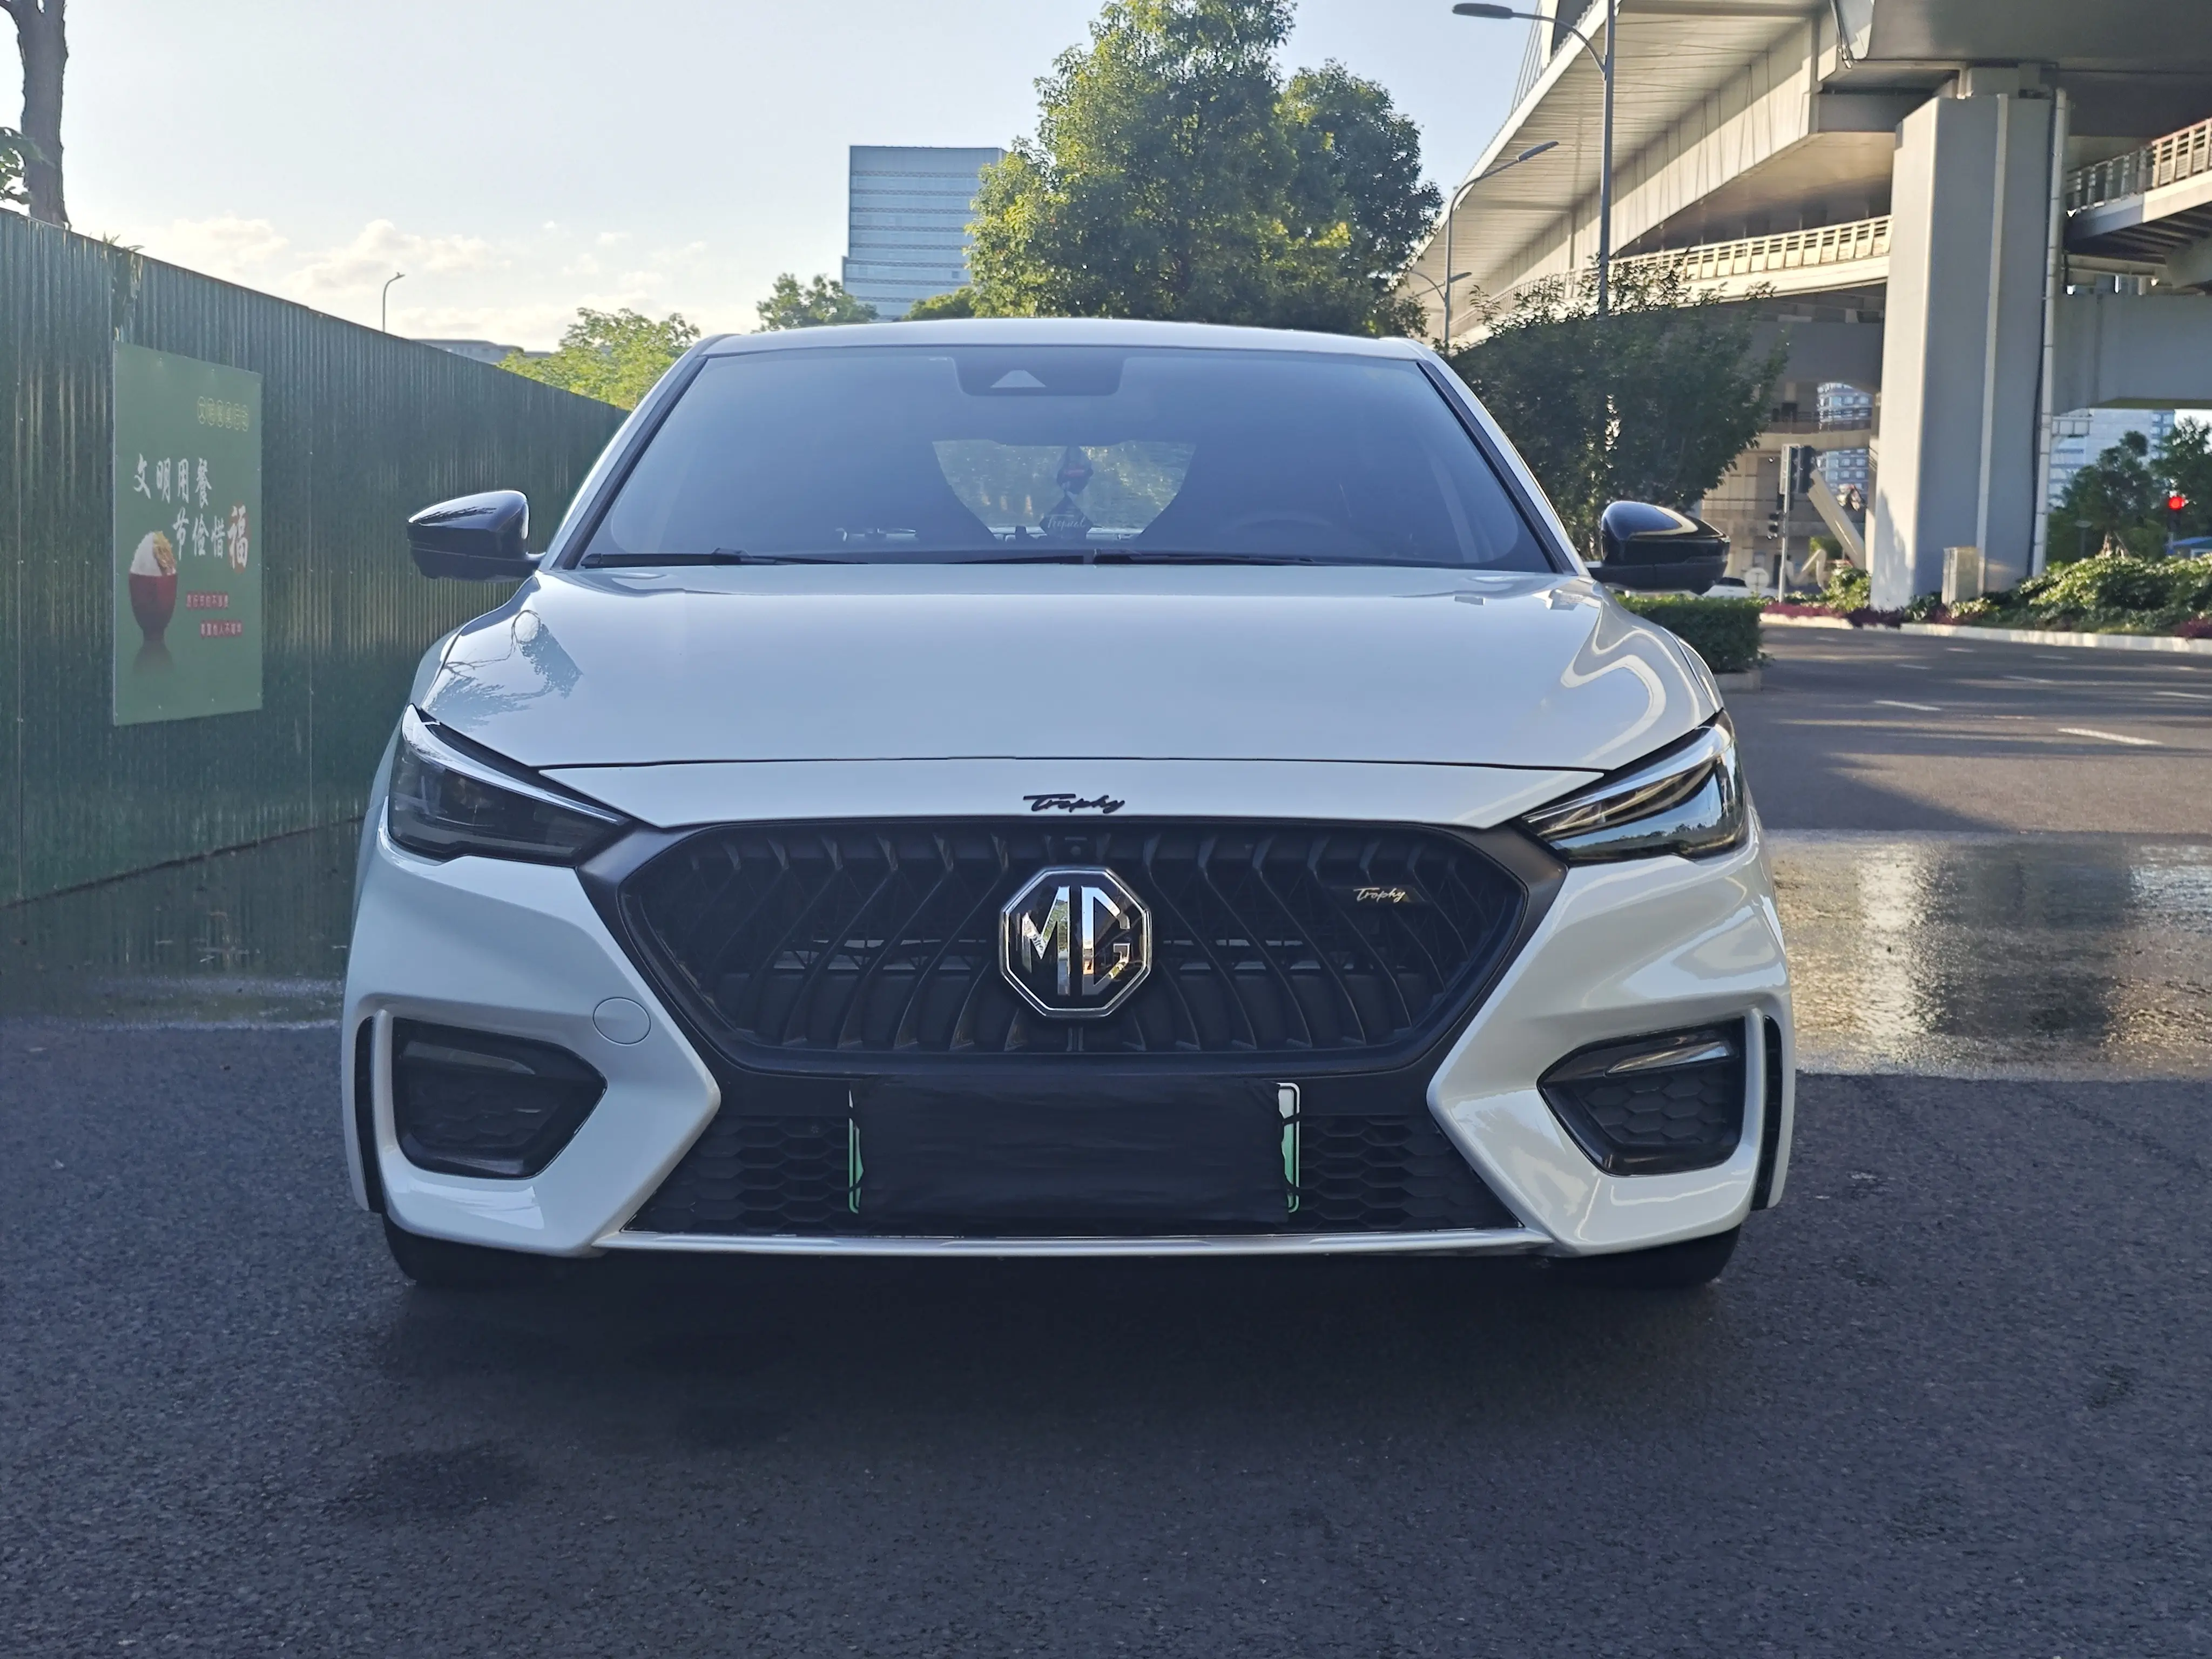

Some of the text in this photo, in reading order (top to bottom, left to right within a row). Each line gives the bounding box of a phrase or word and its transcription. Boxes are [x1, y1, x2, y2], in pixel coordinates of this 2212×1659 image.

[133, 453, 212, 508] 文明用餐
[172, 505, 248, 569] 节俭惜福
[1023, 793, 1125, 814] Trophy
[1353, 887, 1406, 903] Trophy
[1022, 886, 1131, 996] MG
